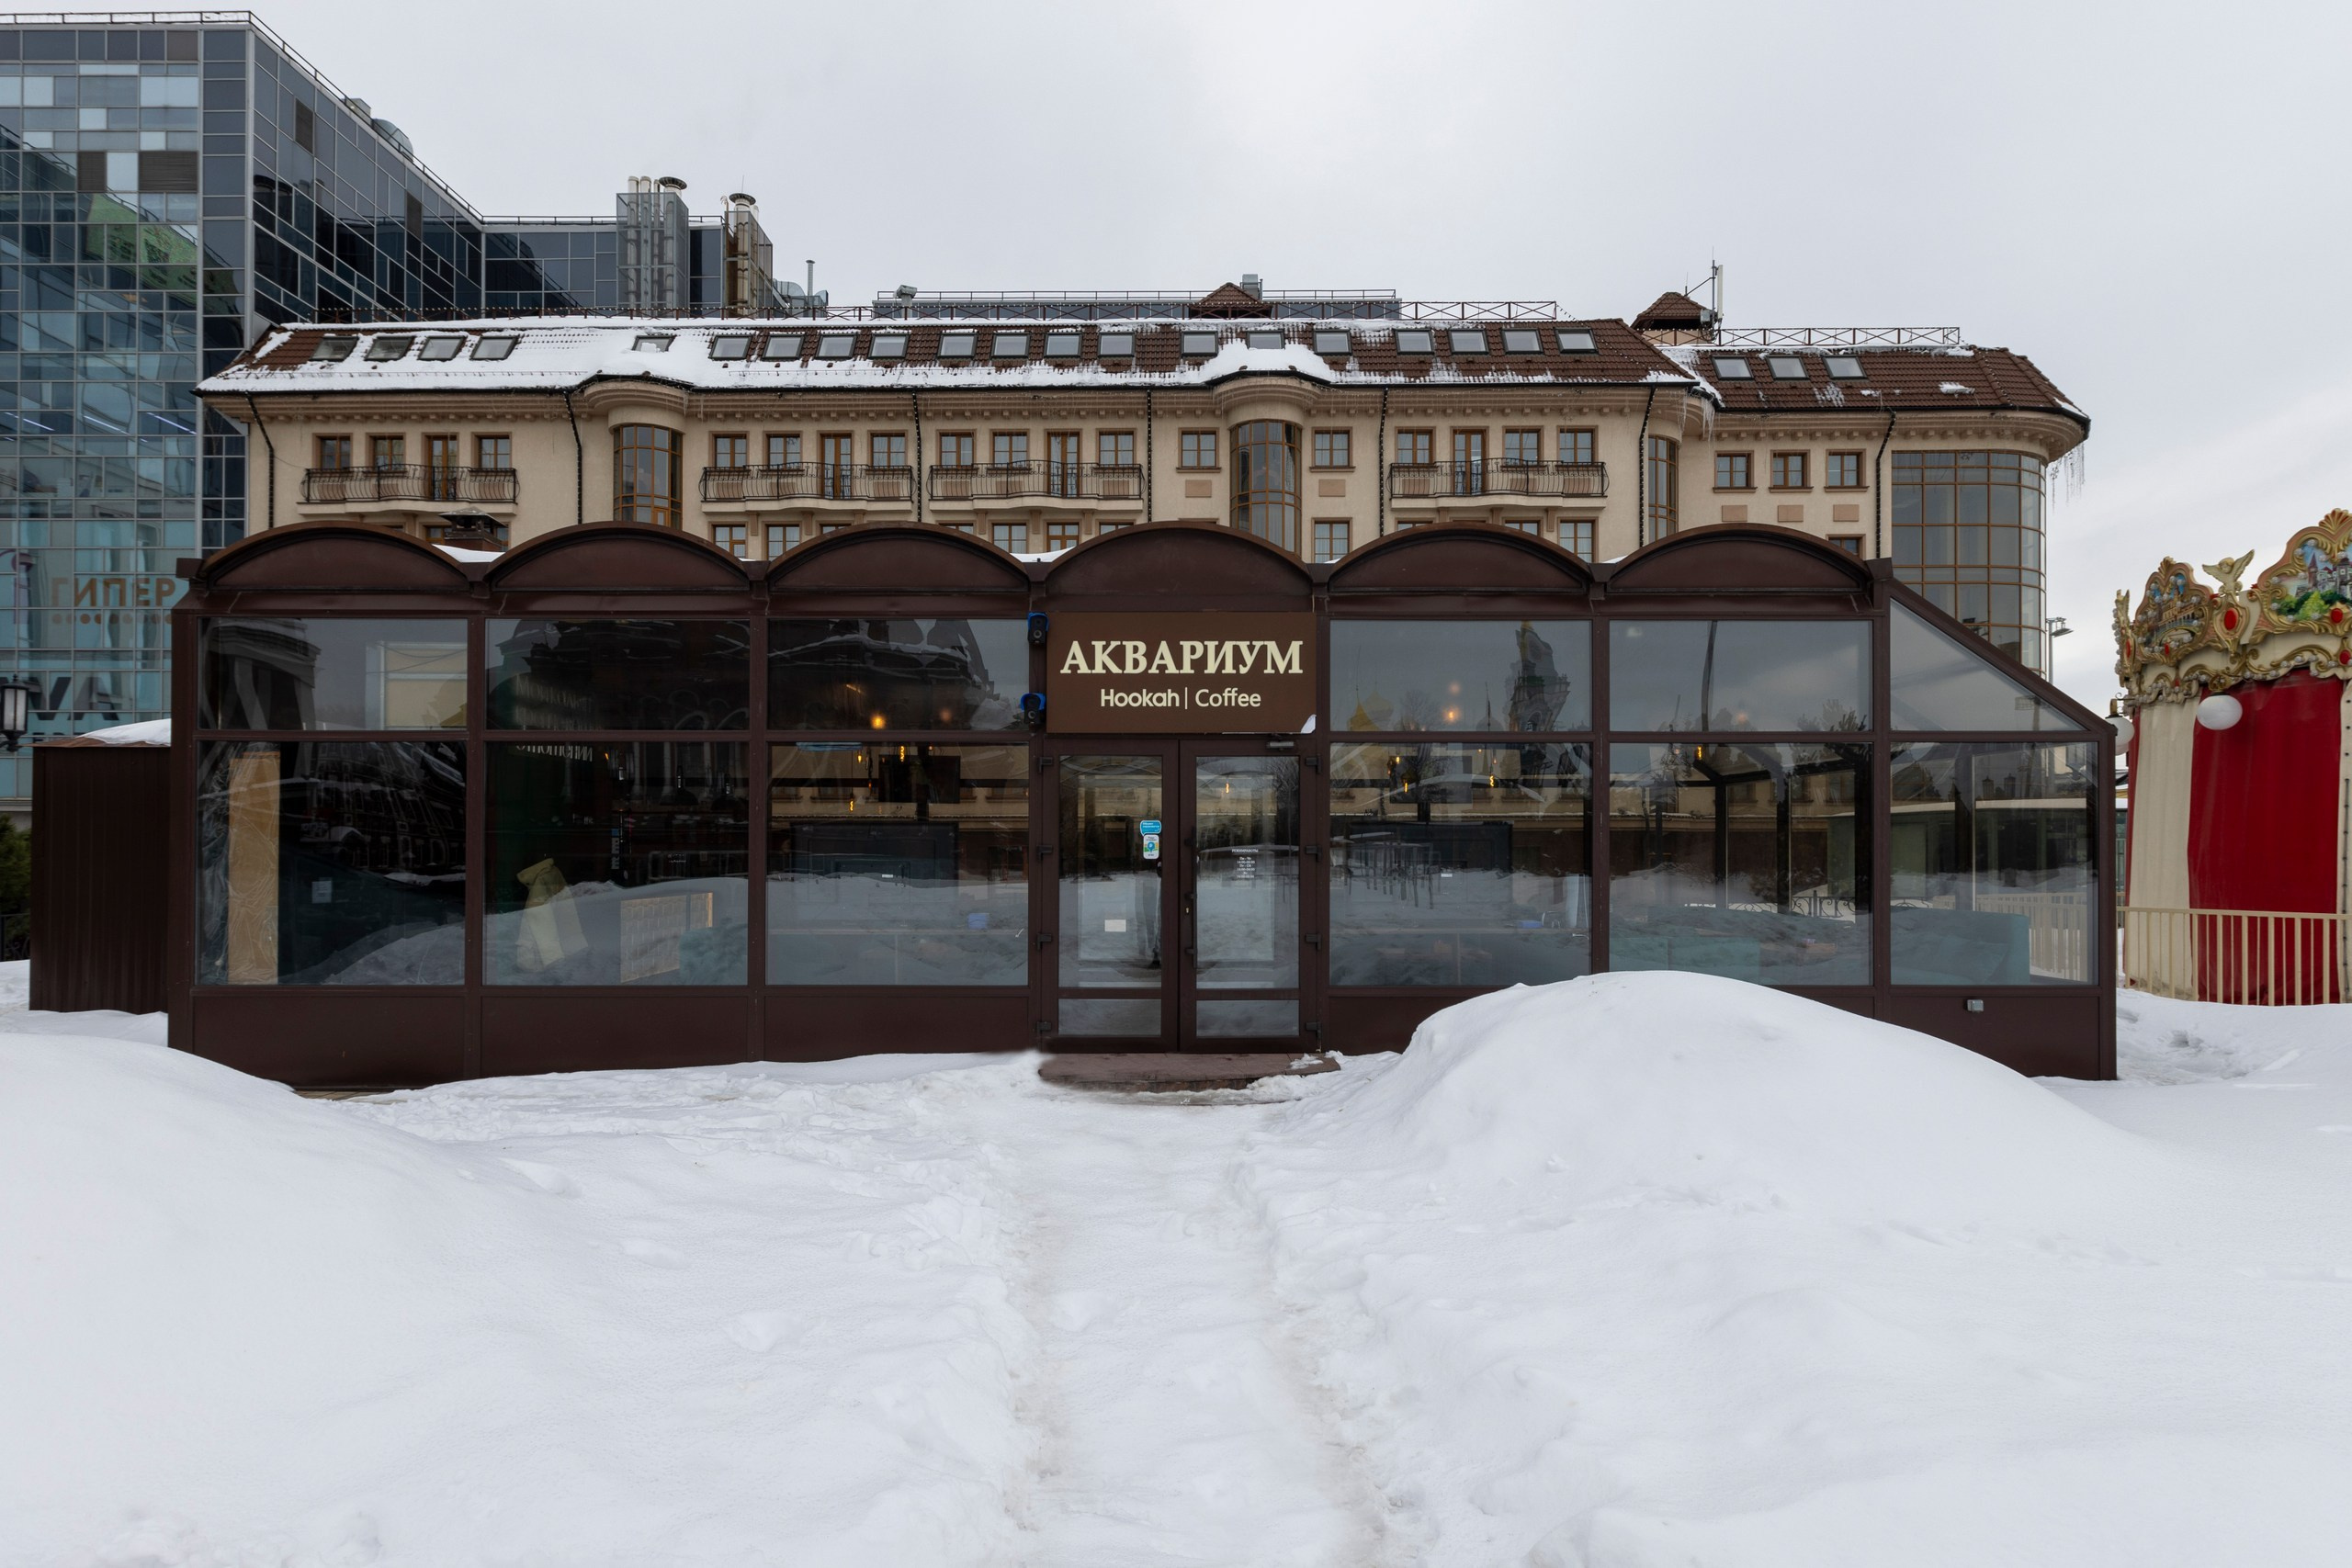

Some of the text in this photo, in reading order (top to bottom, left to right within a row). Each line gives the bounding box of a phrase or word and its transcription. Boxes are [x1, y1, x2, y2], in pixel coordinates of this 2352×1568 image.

[51, 577, 176, 607] ГИПЕР
[1059, 640, 1304, 674] АКВАРИУМ
[1100, 688, 1180, 707] Hookah
[1194, 687, 1261, 707] Coffee
